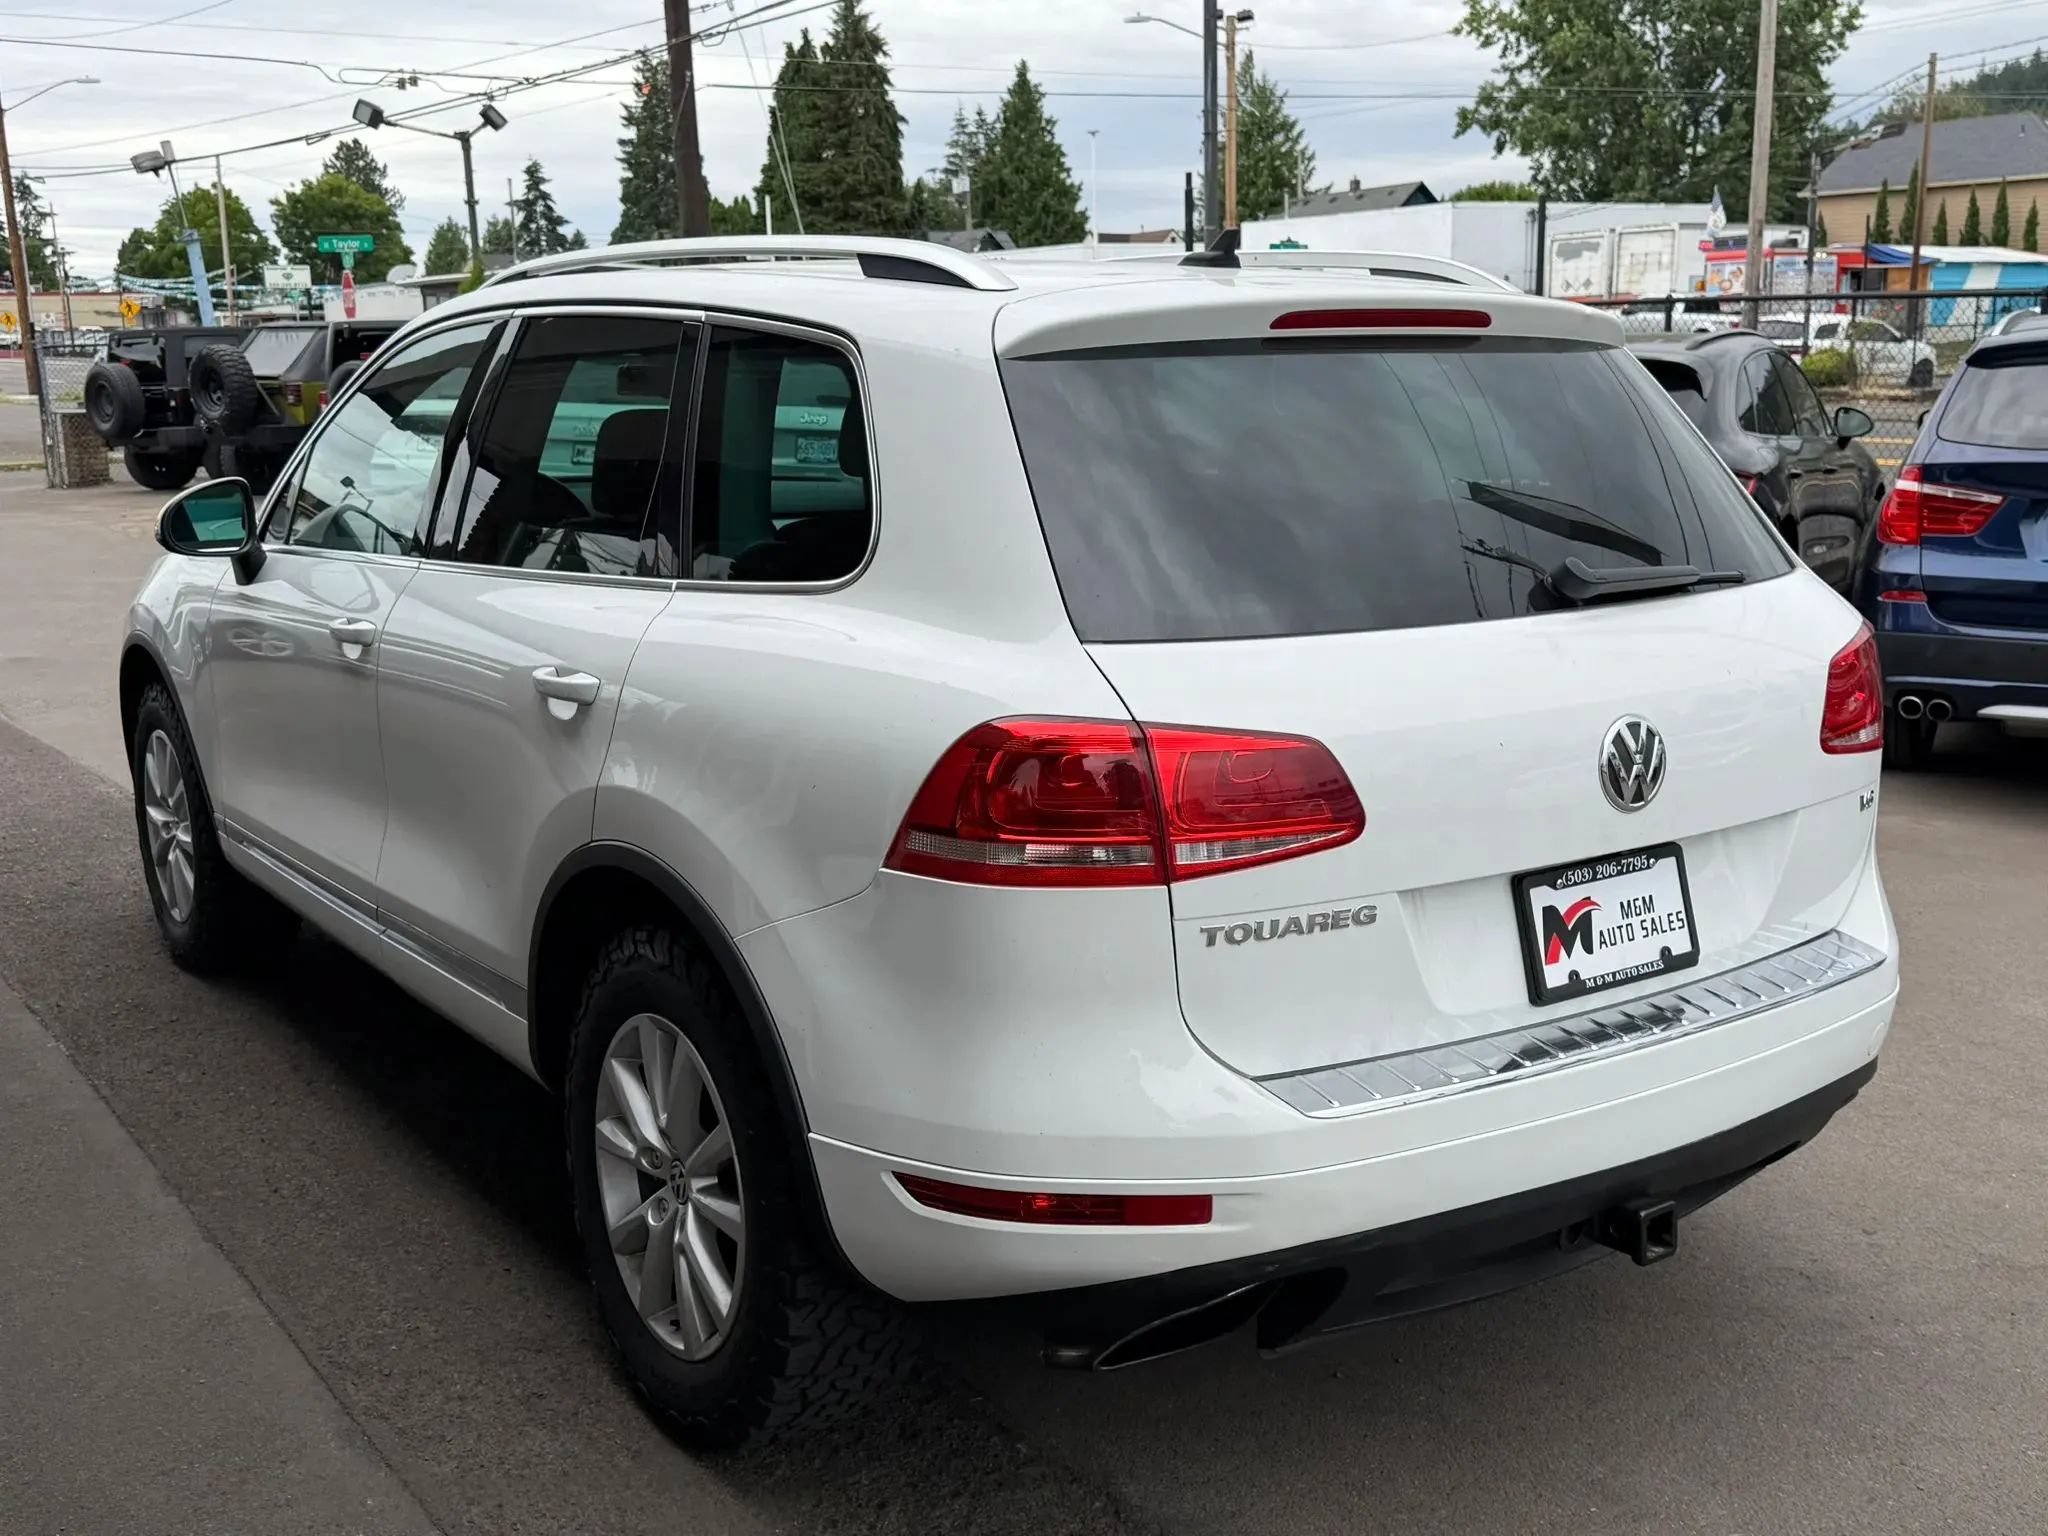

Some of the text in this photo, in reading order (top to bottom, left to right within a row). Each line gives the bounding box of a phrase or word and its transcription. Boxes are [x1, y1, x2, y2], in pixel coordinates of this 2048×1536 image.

[332, 239, 360, 252] Taylor
[800, 412, 828, 426] Jeep
[1562, 854, 1648, 886] (503) 206-7795
[1619, 894, 1656, 921] M&M
[1200, 903, 1377, 947] TOUAREG
[1599, 910, 1686, 950] AUTO SALES
[1585, 978, 1595, 989] M
[1604, 973, 1614, 984] M
[1614, 966, 1638, 981] AUTO
[1638, 960, 1665, 975] SALES
